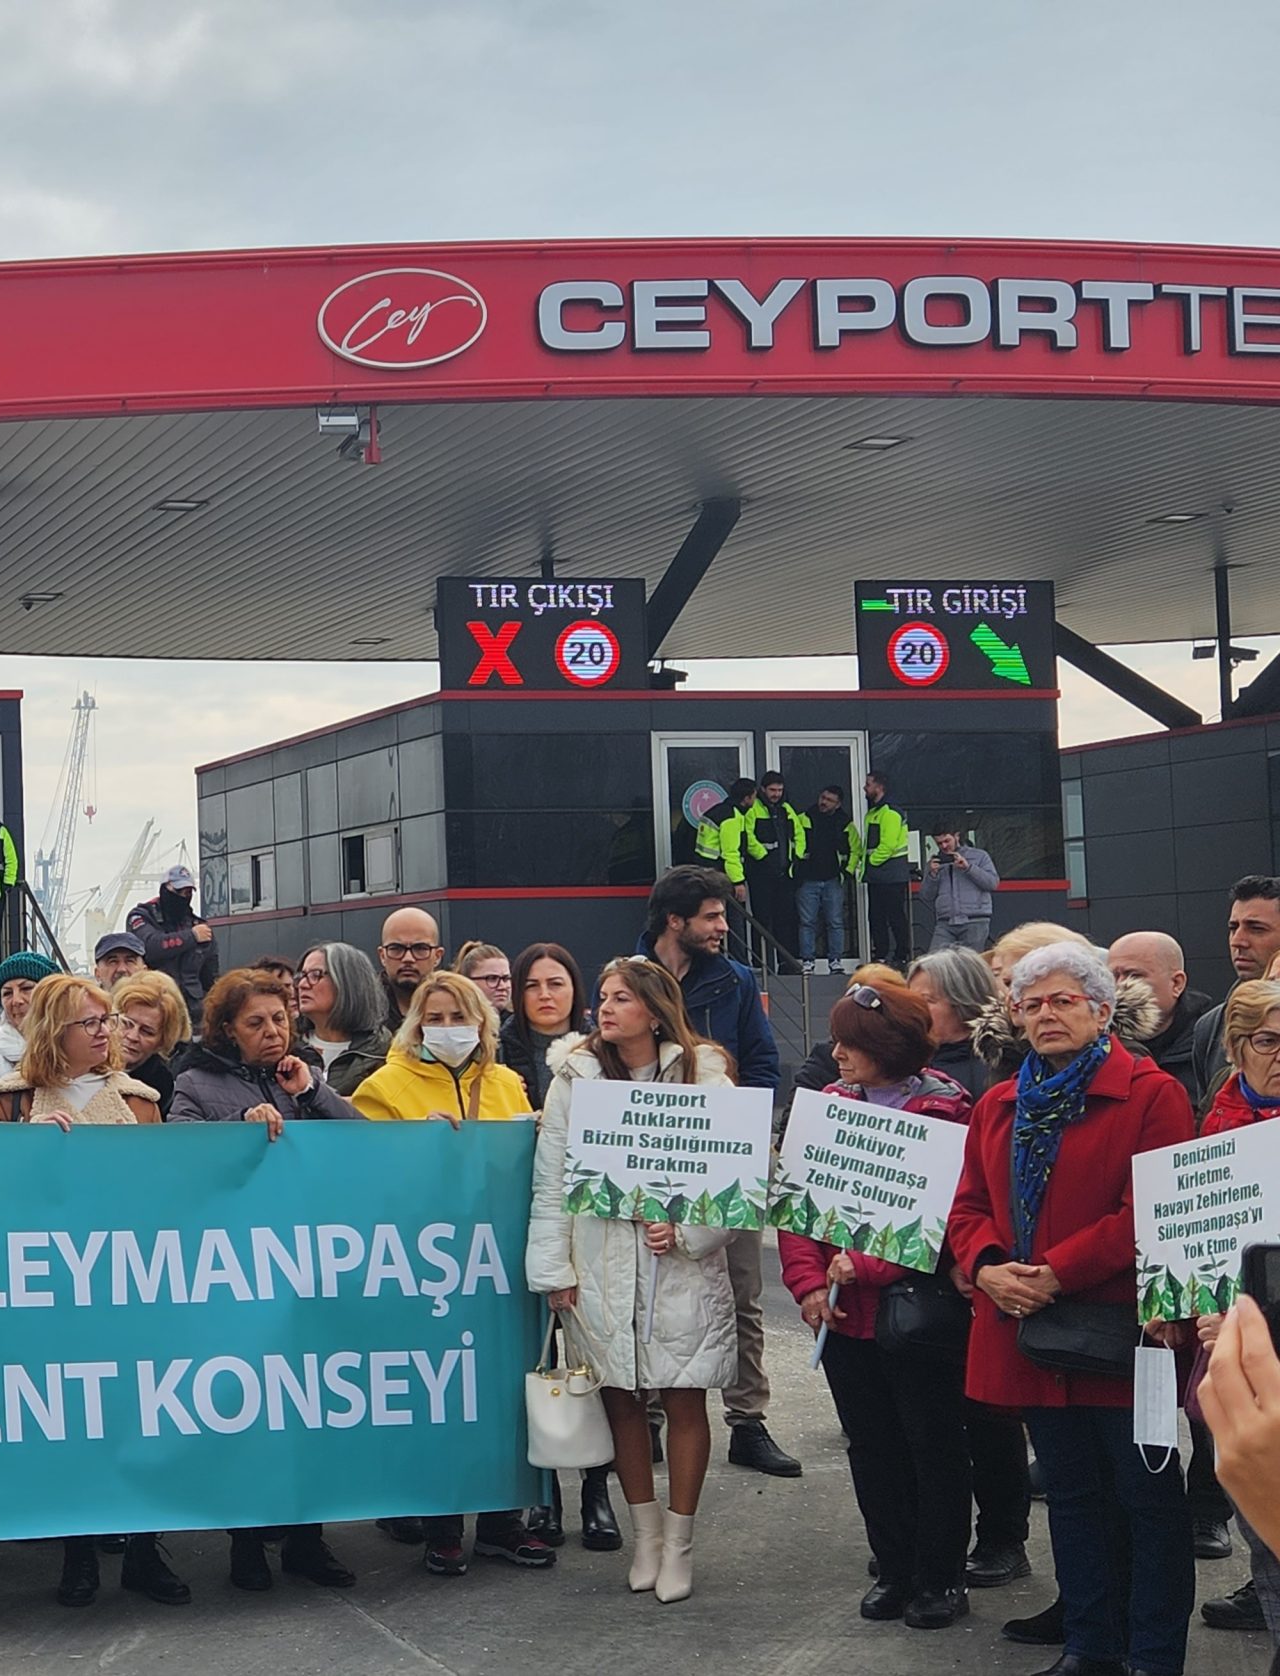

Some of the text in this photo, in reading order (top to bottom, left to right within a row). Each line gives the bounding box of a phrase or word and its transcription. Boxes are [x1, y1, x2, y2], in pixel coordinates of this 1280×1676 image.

[341, 295, 477, 354] Cey
[468, 584, 614, 616] TIR ÇIKIŞI
[886, 584, 1027, 619] TIR GİRİŞİ
[570, 642, 605, 665] 20
[900, 643, 936, 665] 20
[630, 1089, 707, 1109] Ceyport
[621, 1110, 711, 1131] Atıklarını
[826, 1103, 929, 1142] Ceyport Atık
[582, 1129, 753, 1155] Bizim Sağlığımıza
[835, 1128, 906, 1162] Döküyor,
[1173, 1138, 1236, 1169] Denizimizi
[626, 1154, 708, 1175] Bırakma
[803, 1144, 928, 1190] Süleymanpaşa
[1177, 1165, 1234, 1191] Kirletme,
[805, 1167, 917, 1211] Zehir Soluyor
[1154, 1183, 1263, 1219] Havayı Zehirleme,
[1158, 1206, 1263, 1241] Süleymanpaşa'yı
[1183, 1236, 1237, 1260] Yok Etme
[136, 1330, 478, 1437] KONSEYİ
